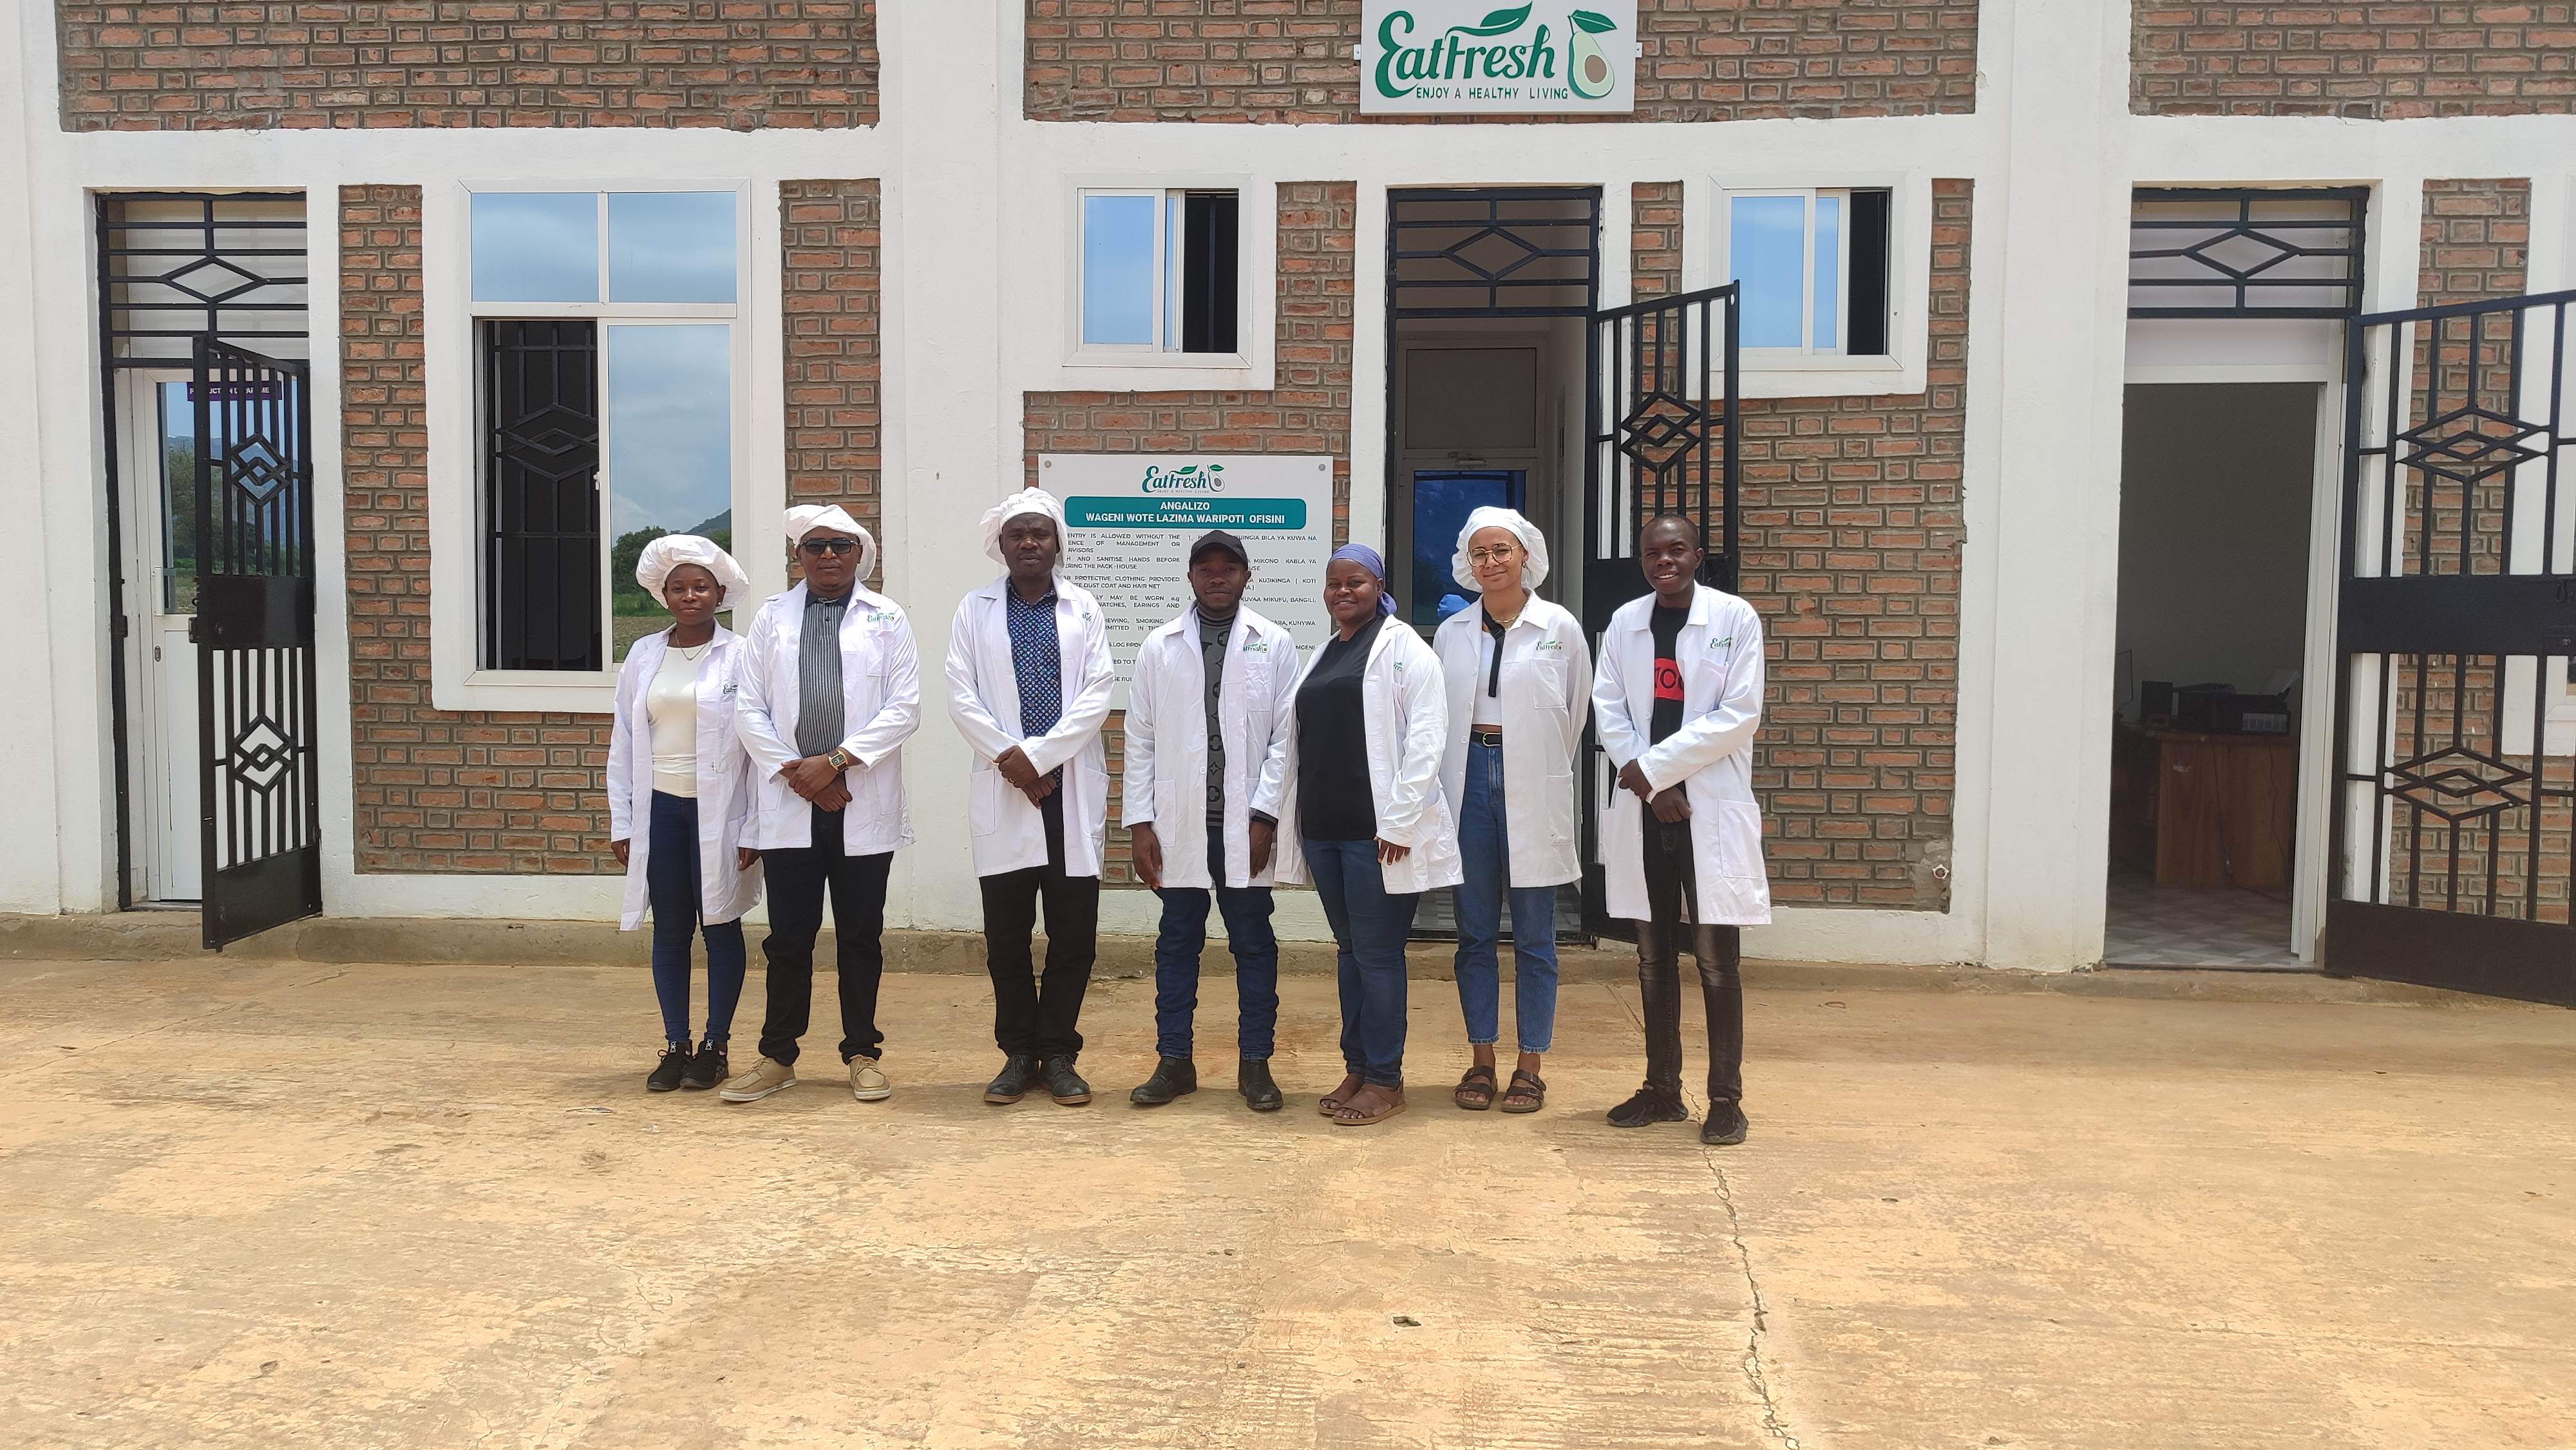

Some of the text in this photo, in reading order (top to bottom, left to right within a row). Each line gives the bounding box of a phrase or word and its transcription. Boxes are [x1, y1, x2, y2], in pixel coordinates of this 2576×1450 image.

[1416, 88, 1568, 99] ENJOY A HEALTHY LIVING
[1160, 501, 1210, 511] ANGALIZO
[1086, 513, 1285, 524] WAGENI WOTE LAZIMA WARIPOTI OFISINI
